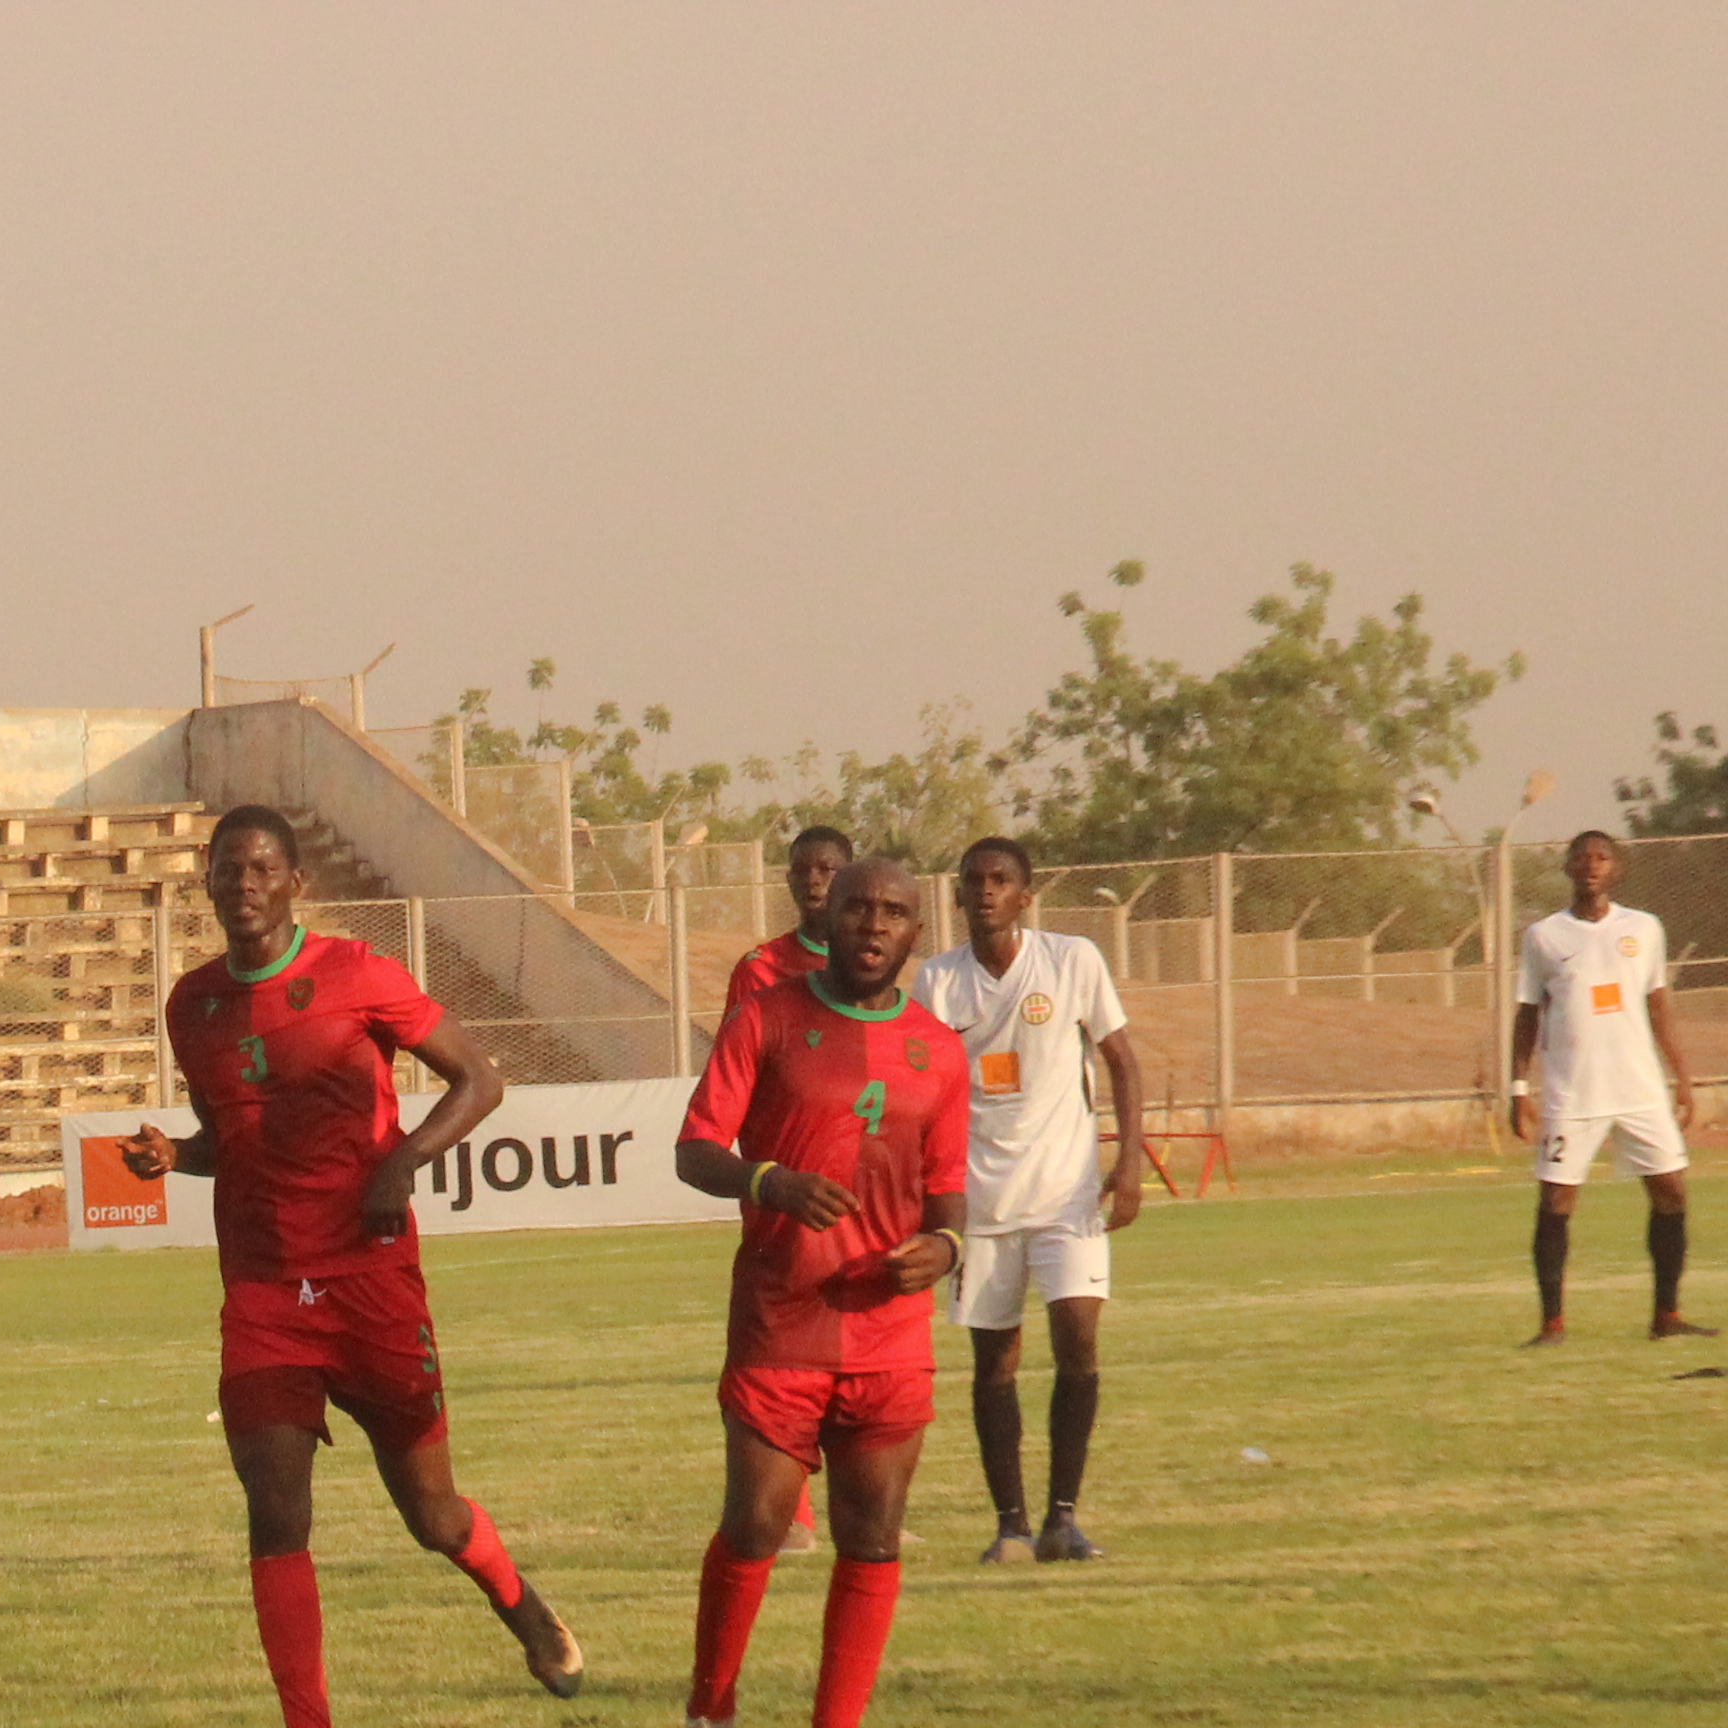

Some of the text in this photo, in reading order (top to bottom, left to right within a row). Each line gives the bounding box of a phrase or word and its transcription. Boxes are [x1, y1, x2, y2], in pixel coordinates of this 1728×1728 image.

[238, 1035, 266, 1083] 3
[852, 1080, 886, 1134] 4
[87, 1203, 159, 1224] orange
